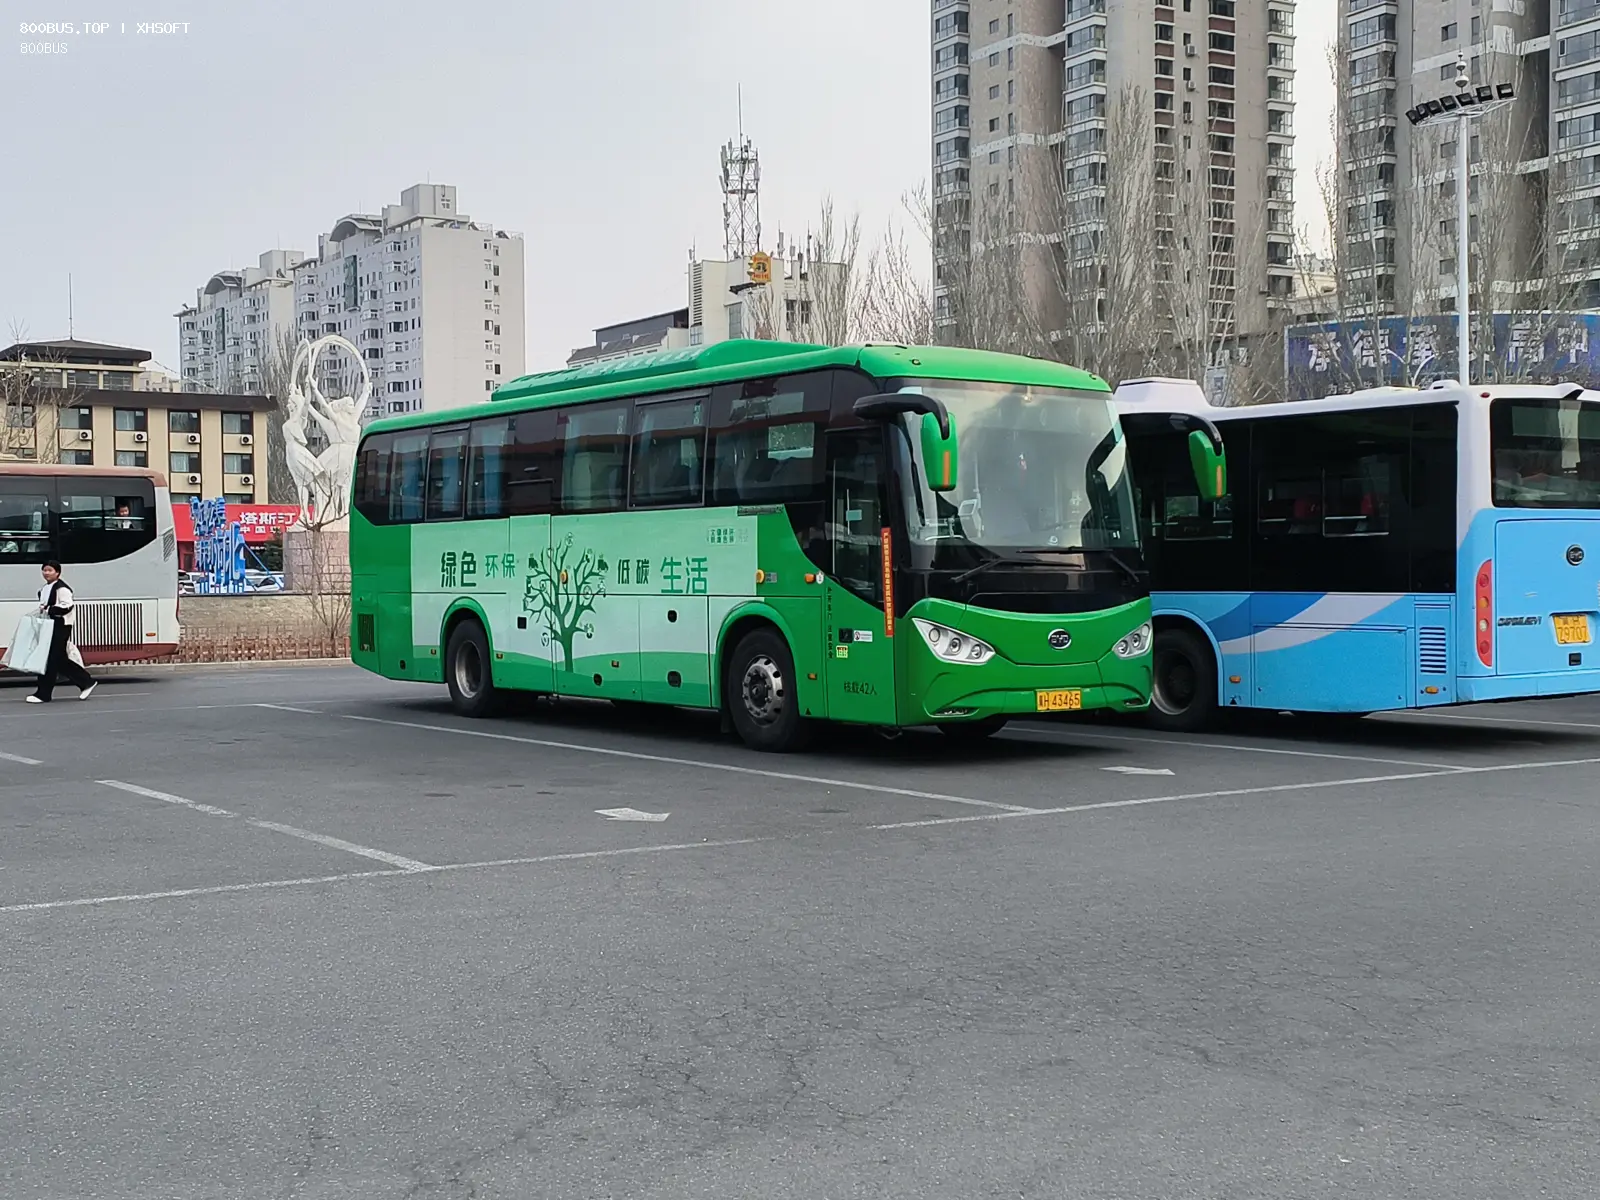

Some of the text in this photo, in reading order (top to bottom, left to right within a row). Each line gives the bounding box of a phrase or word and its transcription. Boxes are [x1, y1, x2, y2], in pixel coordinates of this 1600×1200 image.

[239, 512, 296, 525] 塔斯汀
[440, 550, 516, 588] 绿色 环保
[617, 556, 709, 595] 低碳 生活
